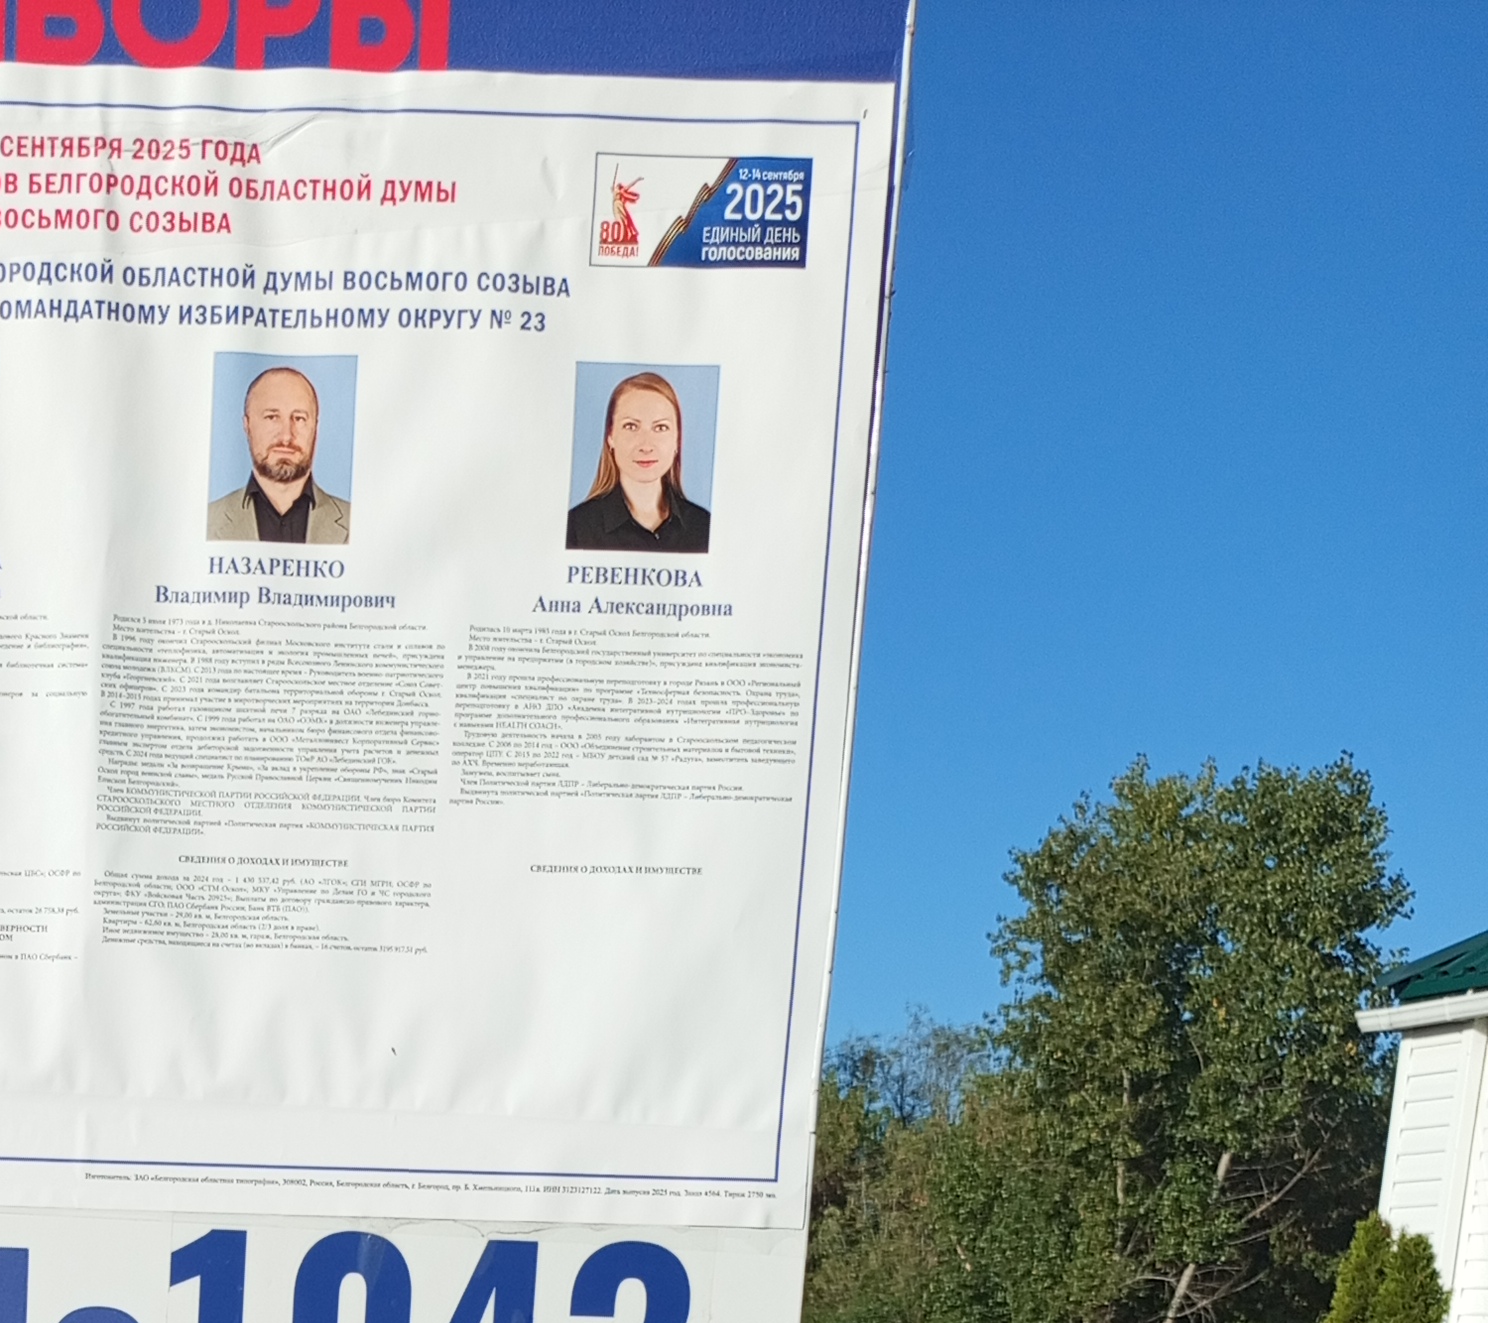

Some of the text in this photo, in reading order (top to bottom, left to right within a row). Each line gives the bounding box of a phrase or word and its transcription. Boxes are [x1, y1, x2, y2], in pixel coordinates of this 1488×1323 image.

[0, 136, 121, 158] СЕНТЯБРЯ
[132, 138, 190, 160] 2025
[202, 140, 260, 166] ГОДА
[29, 172, 218, 199] БЕЛГОРОДСКОЙ
[229, 175, 371, 201] ОБЛАСТНОЙ
[380, 180, 456, 205] ДУМЫ
[724, 183, 803, 221] 2025
[130, 211, 231, 233] СОЗЫВА
[703, 224, 800, 245] ЕДИНЫЙ ДЕНЬ
[123, 264, 255, 288] ОБЛАСТНОЙ
[263, 271, 333, 294] ДУМЫ
[343, 271, 467, 291] ВОСЬМОГО
[477, 272, 570, 297] СОЗЫВА
[179, 305, 390, 328] ИЗБИРАТЕЛЬНОМУ
[398, 308, 482, 329] ОКРУГУ
[490, 309, 511, 328] №
[520, 311, 545, 332] 23
[210, 557, 344, 577] НАЗАРЕНКО
[568, 566, 702, 587] РЕВЕНКОВА
[156, 585, 395, 611] Владимир Владимирович
[532, 596, 732, 620] Анна Александровна
